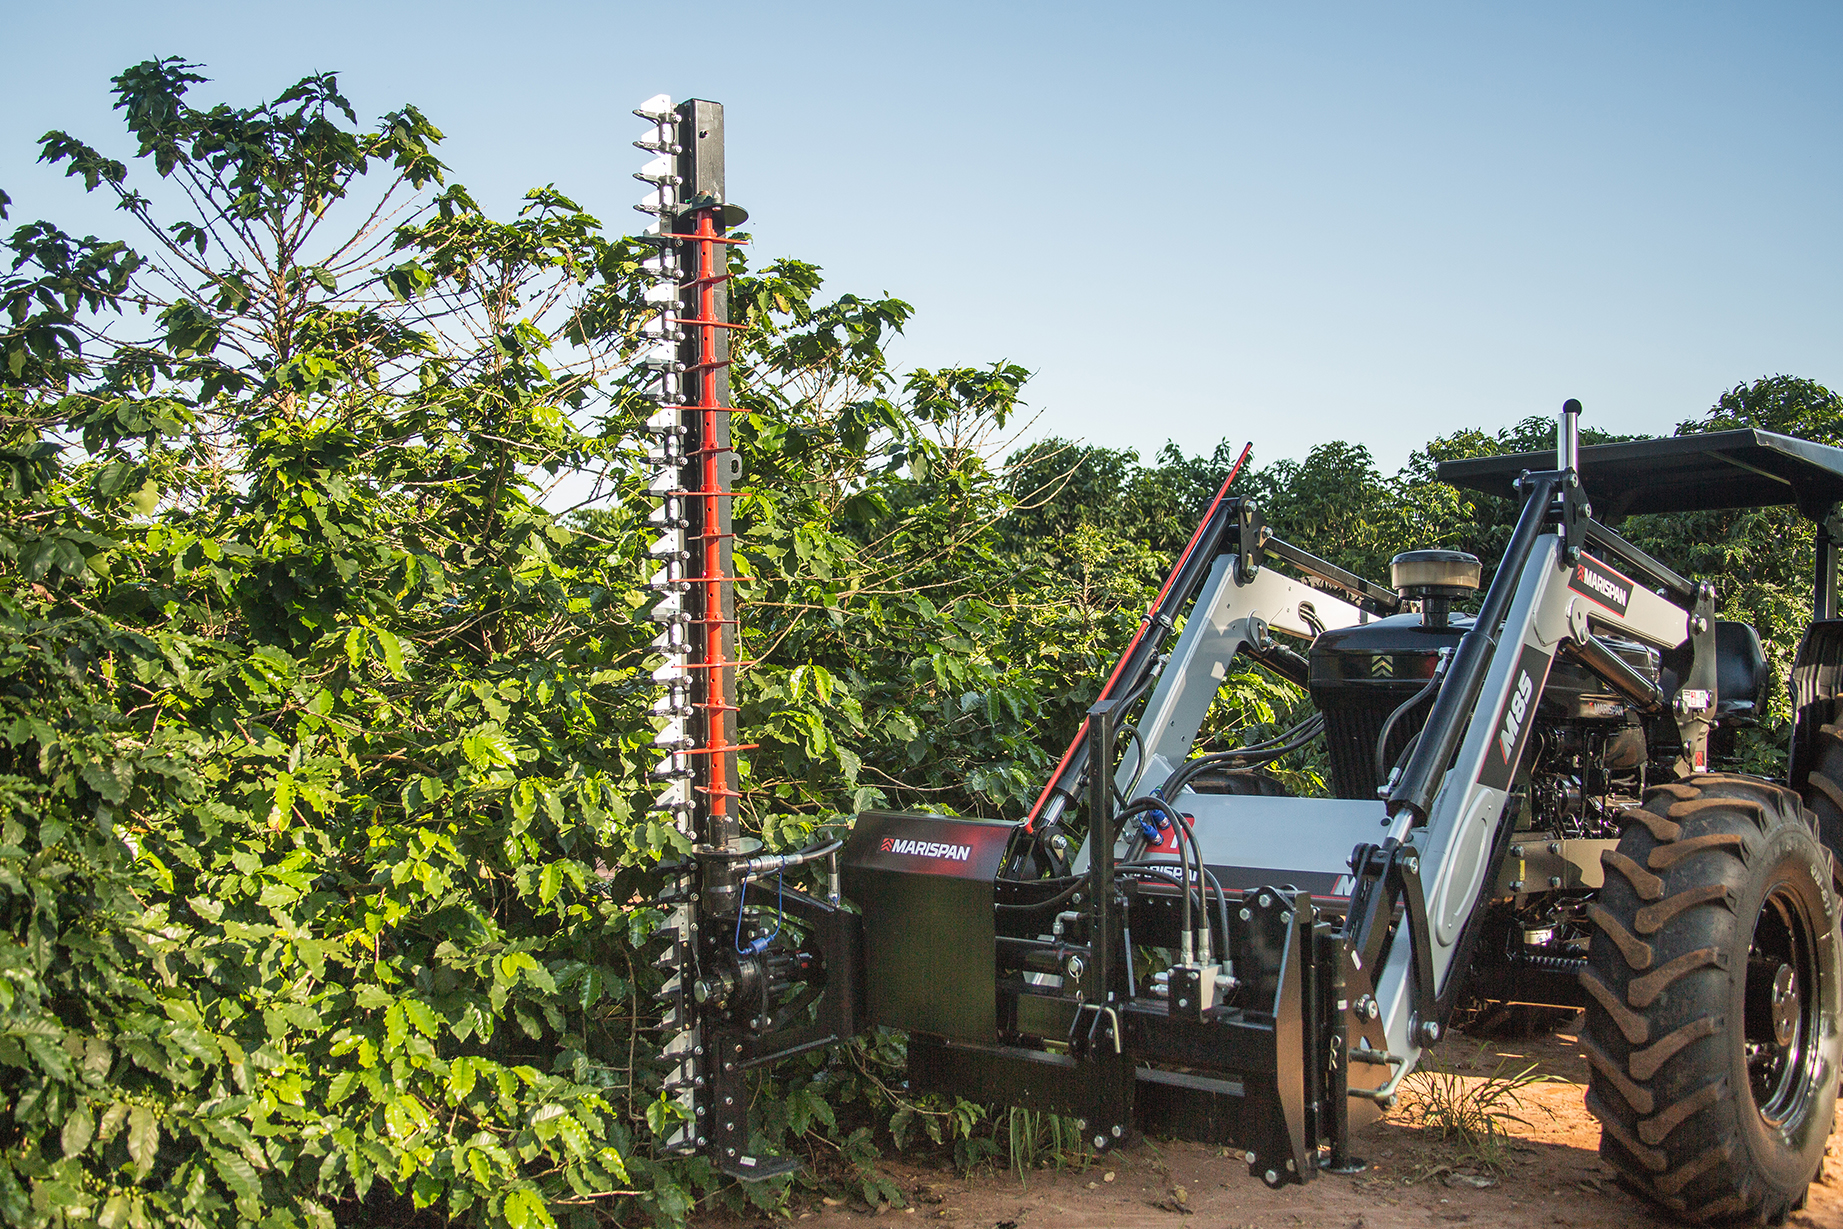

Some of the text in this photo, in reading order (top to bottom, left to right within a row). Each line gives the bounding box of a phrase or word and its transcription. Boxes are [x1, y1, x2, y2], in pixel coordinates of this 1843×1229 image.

[1584, 567, 1627, 606] MARISPAN
[1500, 669, 1533, 761] M85
[1594, 702, 1624, 716] MARISPAN
[892, 839, 971, 861] MARISPAN
